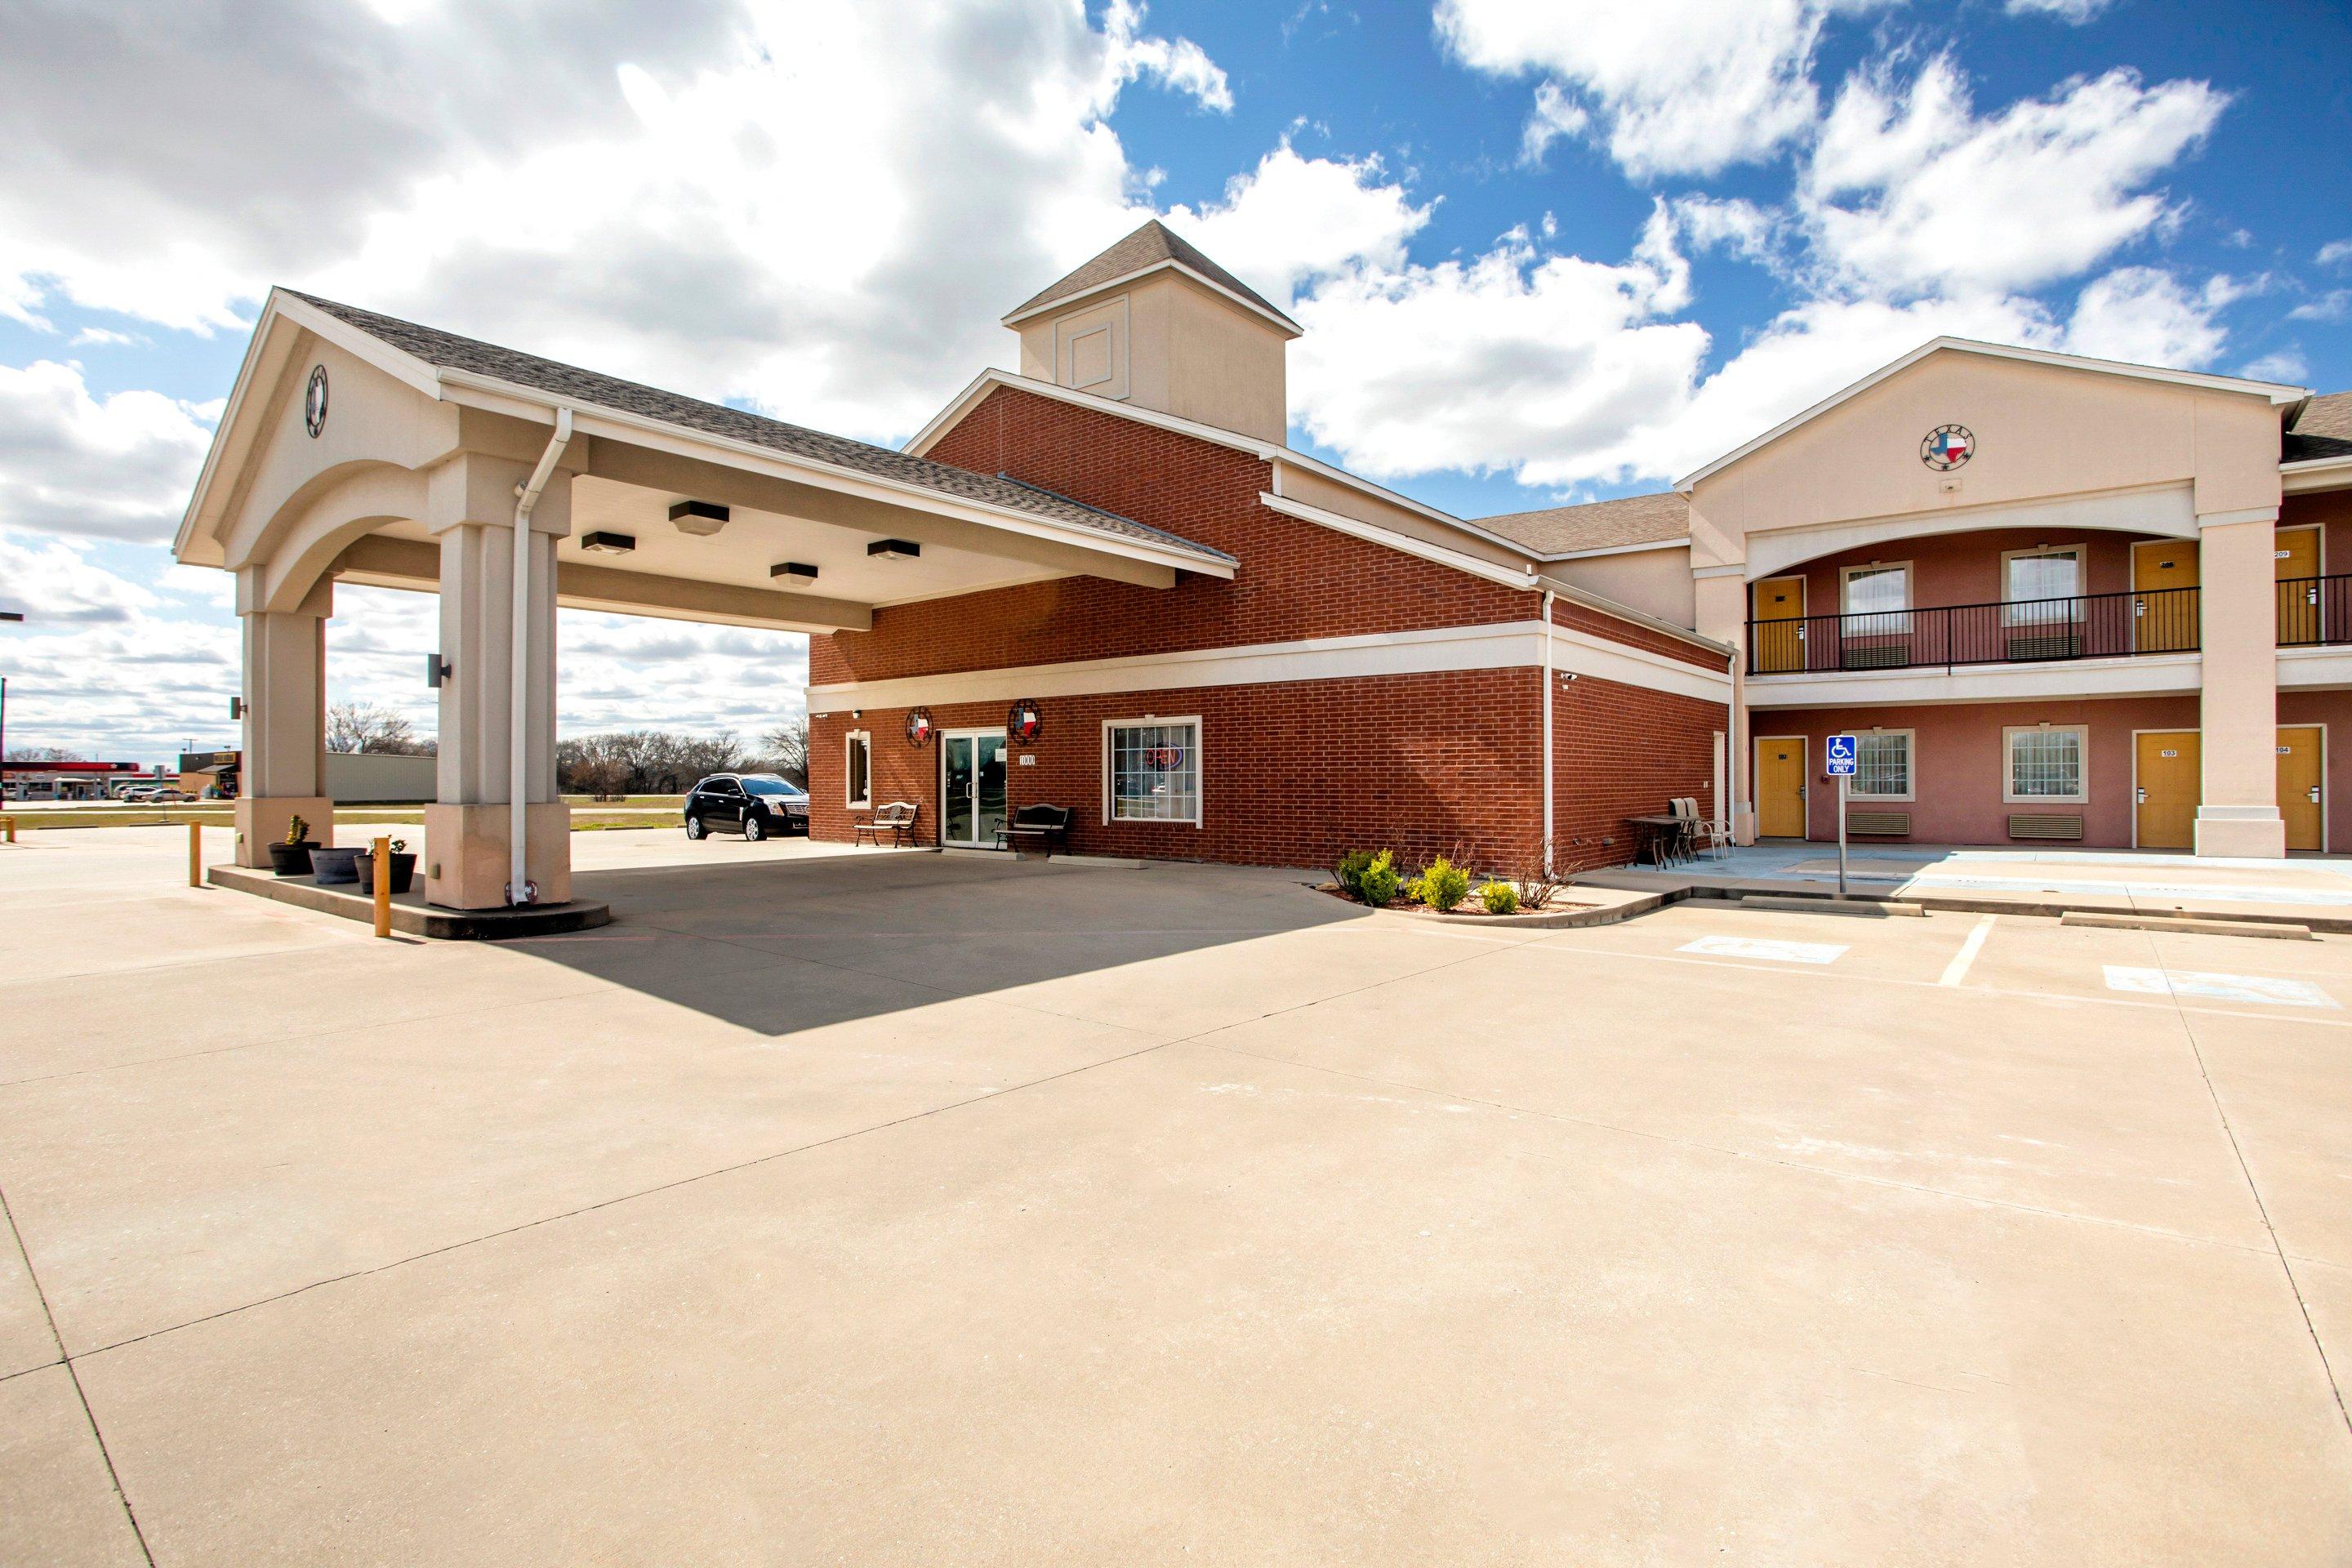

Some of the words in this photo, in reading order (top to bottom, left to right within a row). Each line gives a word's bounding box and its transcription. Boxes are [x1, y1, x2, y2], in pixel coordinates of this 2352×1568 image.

[1923, 424, 1972, 442] TEXAS
[1146, 749, 1176, 764] OPEN
[1829, 758, 1854, 766] PARKING
[1833, 765, 1849, 773] ONLY
